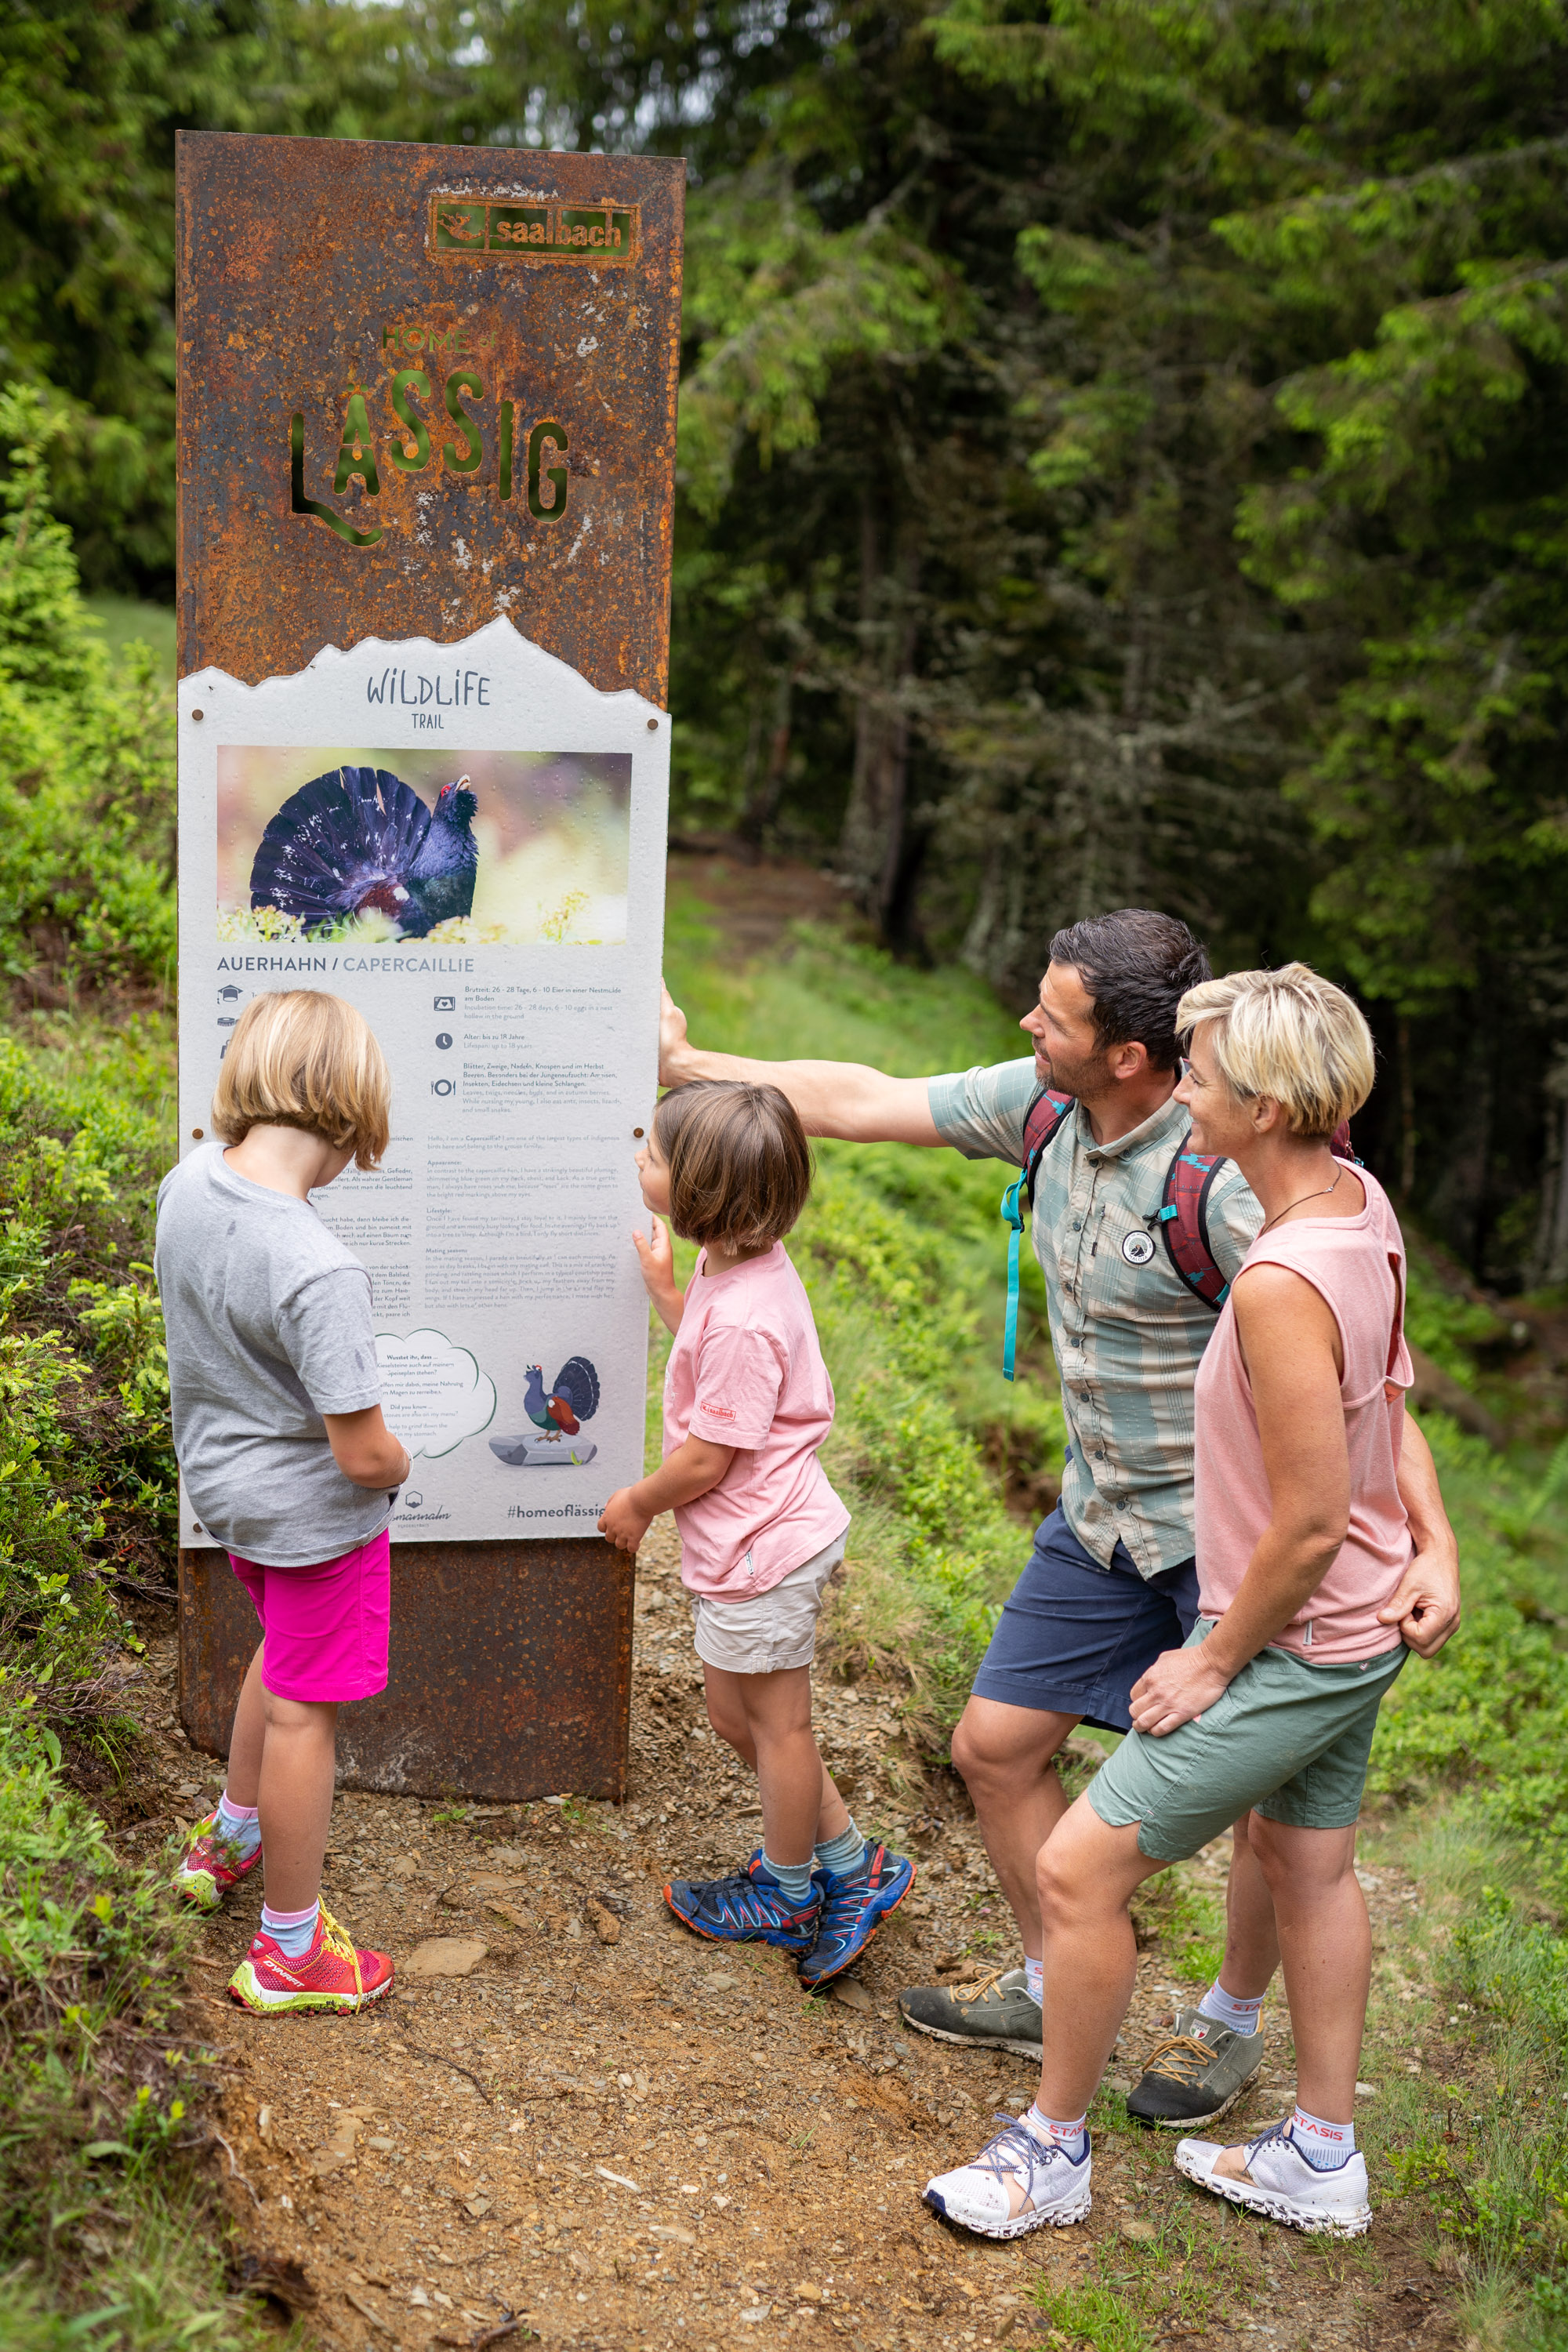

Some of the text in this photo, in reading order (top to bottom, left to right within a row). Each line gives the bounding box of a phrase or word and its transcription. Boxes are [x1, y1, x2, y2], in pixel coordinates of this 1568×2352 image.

[496, 208, 621, 248] saalbach
[383, 326, 497, 353] HOME of
[291, 369, 568, 547] LÄSSIG
[412, 713, 444, 728] TRAIL
[216, 957, 474, 972] AUERHAHN / CAPERCAILLIE
[710, 1407, 734, 1418] saalbach
[263, 1960, 305, 1987] DYNAFIT
[1231, 2002, 1260, 2012] STA
[1293, 2111, 1344, 2141] STASIS
